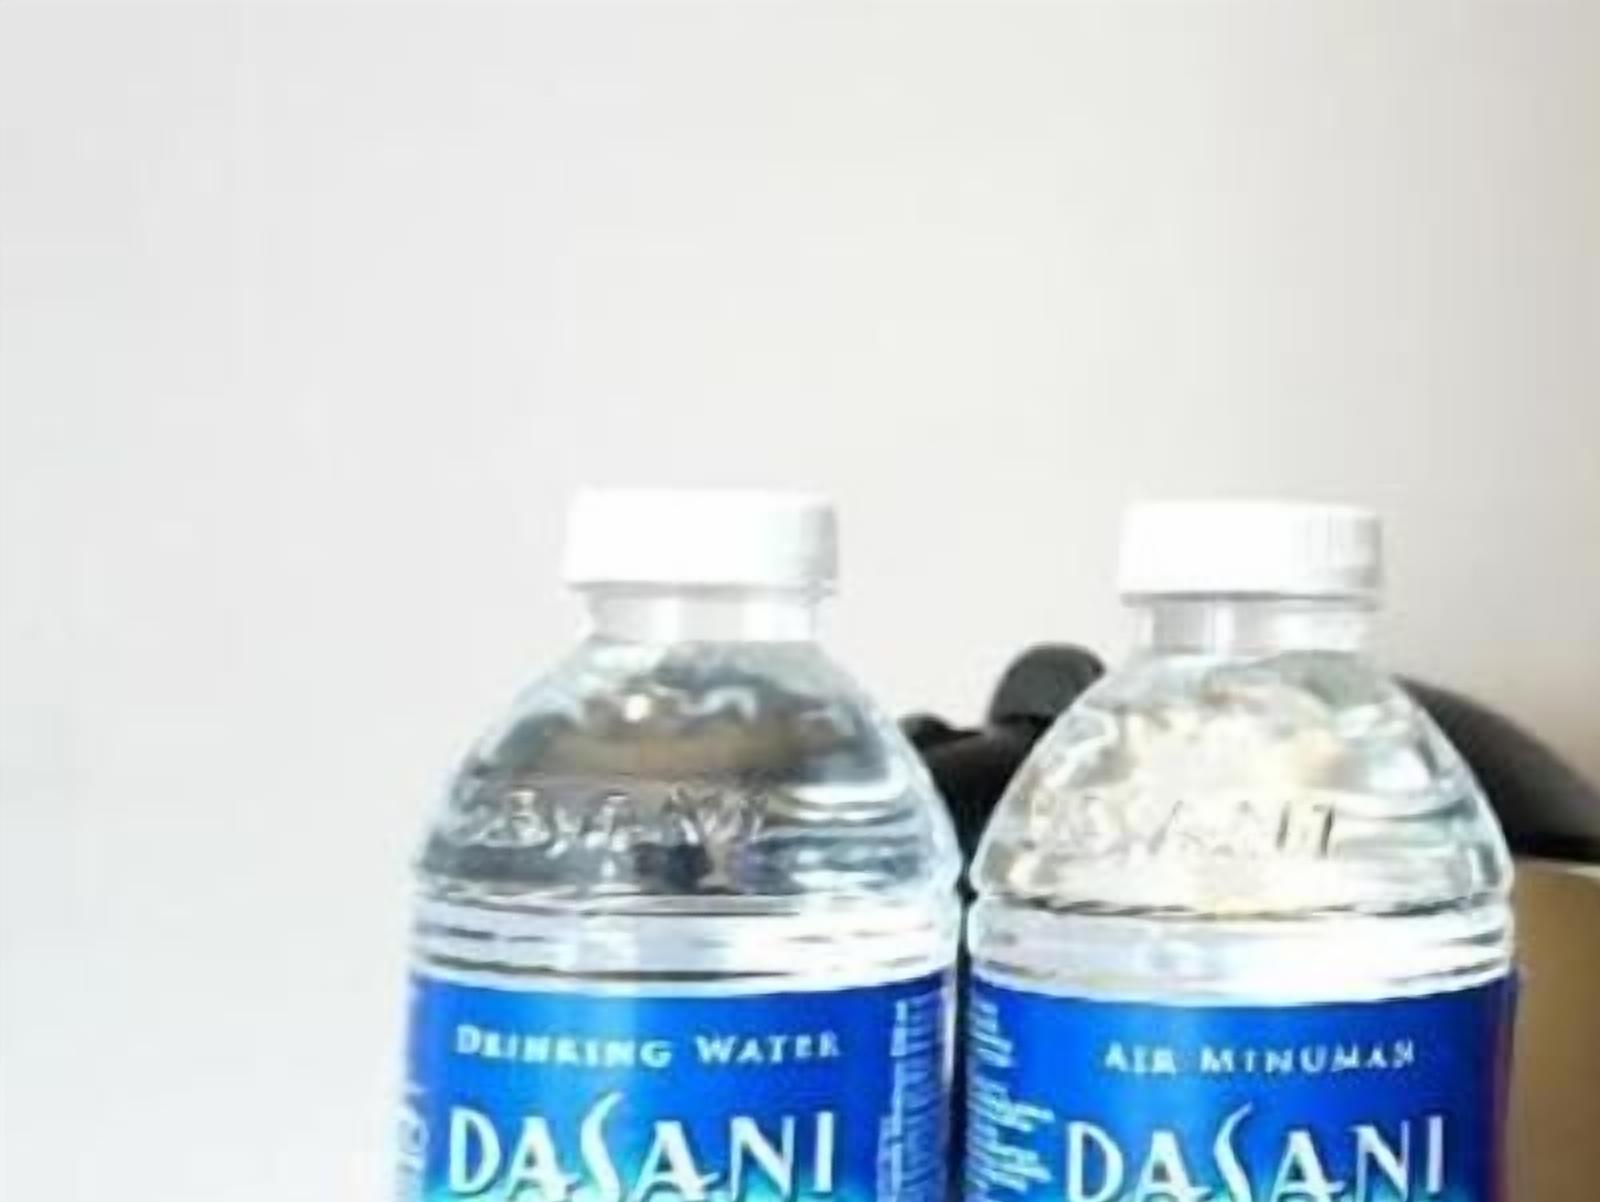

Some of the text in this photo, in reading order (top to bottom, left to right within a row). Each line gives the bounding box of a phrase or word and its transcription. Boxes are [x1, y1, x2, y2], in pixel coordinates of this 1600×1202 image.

[456, 1024, 840, 1067] DRINKING WATER
[1105, 1039, 1414, 1074] AIR MINUMAN
